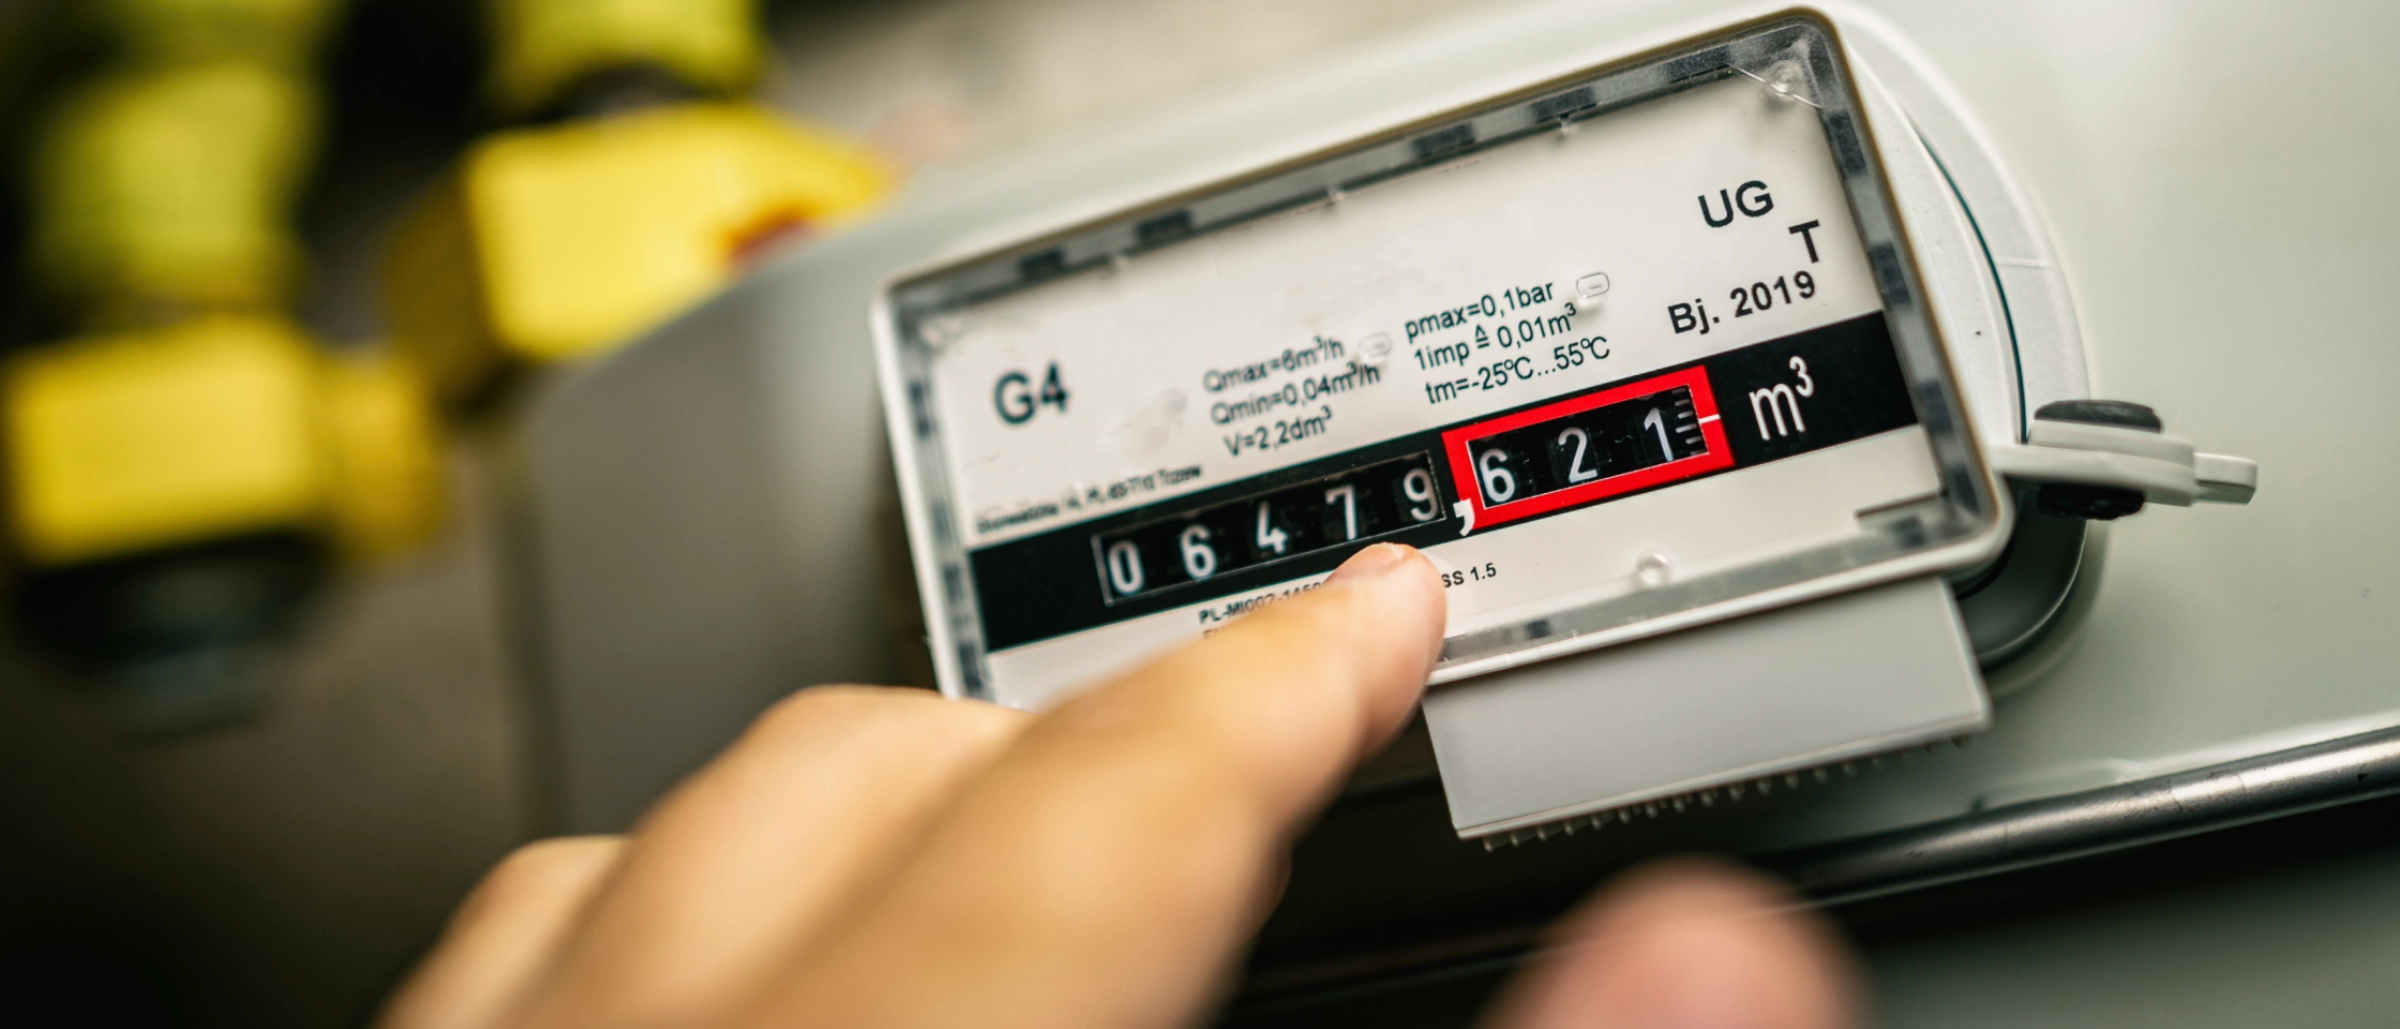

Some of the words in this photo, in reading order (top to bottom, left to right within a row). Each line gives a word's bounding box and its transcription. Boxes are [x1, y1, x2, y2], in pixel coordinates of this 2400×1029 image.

[1698, 180, 1774, 228] UG
[1788, 219, 1820, 263] T
[1405, 282, 1553, 344] pmax=0,1bar
[1668, 298, 1720, 335] Bj.
[1730, 270, 1815, 318] 2019
[1414, 341, 1470, 371] 1imp
[993, 361, 1069, 425] G4
[1470, 562, 1497, 581] 1.5
